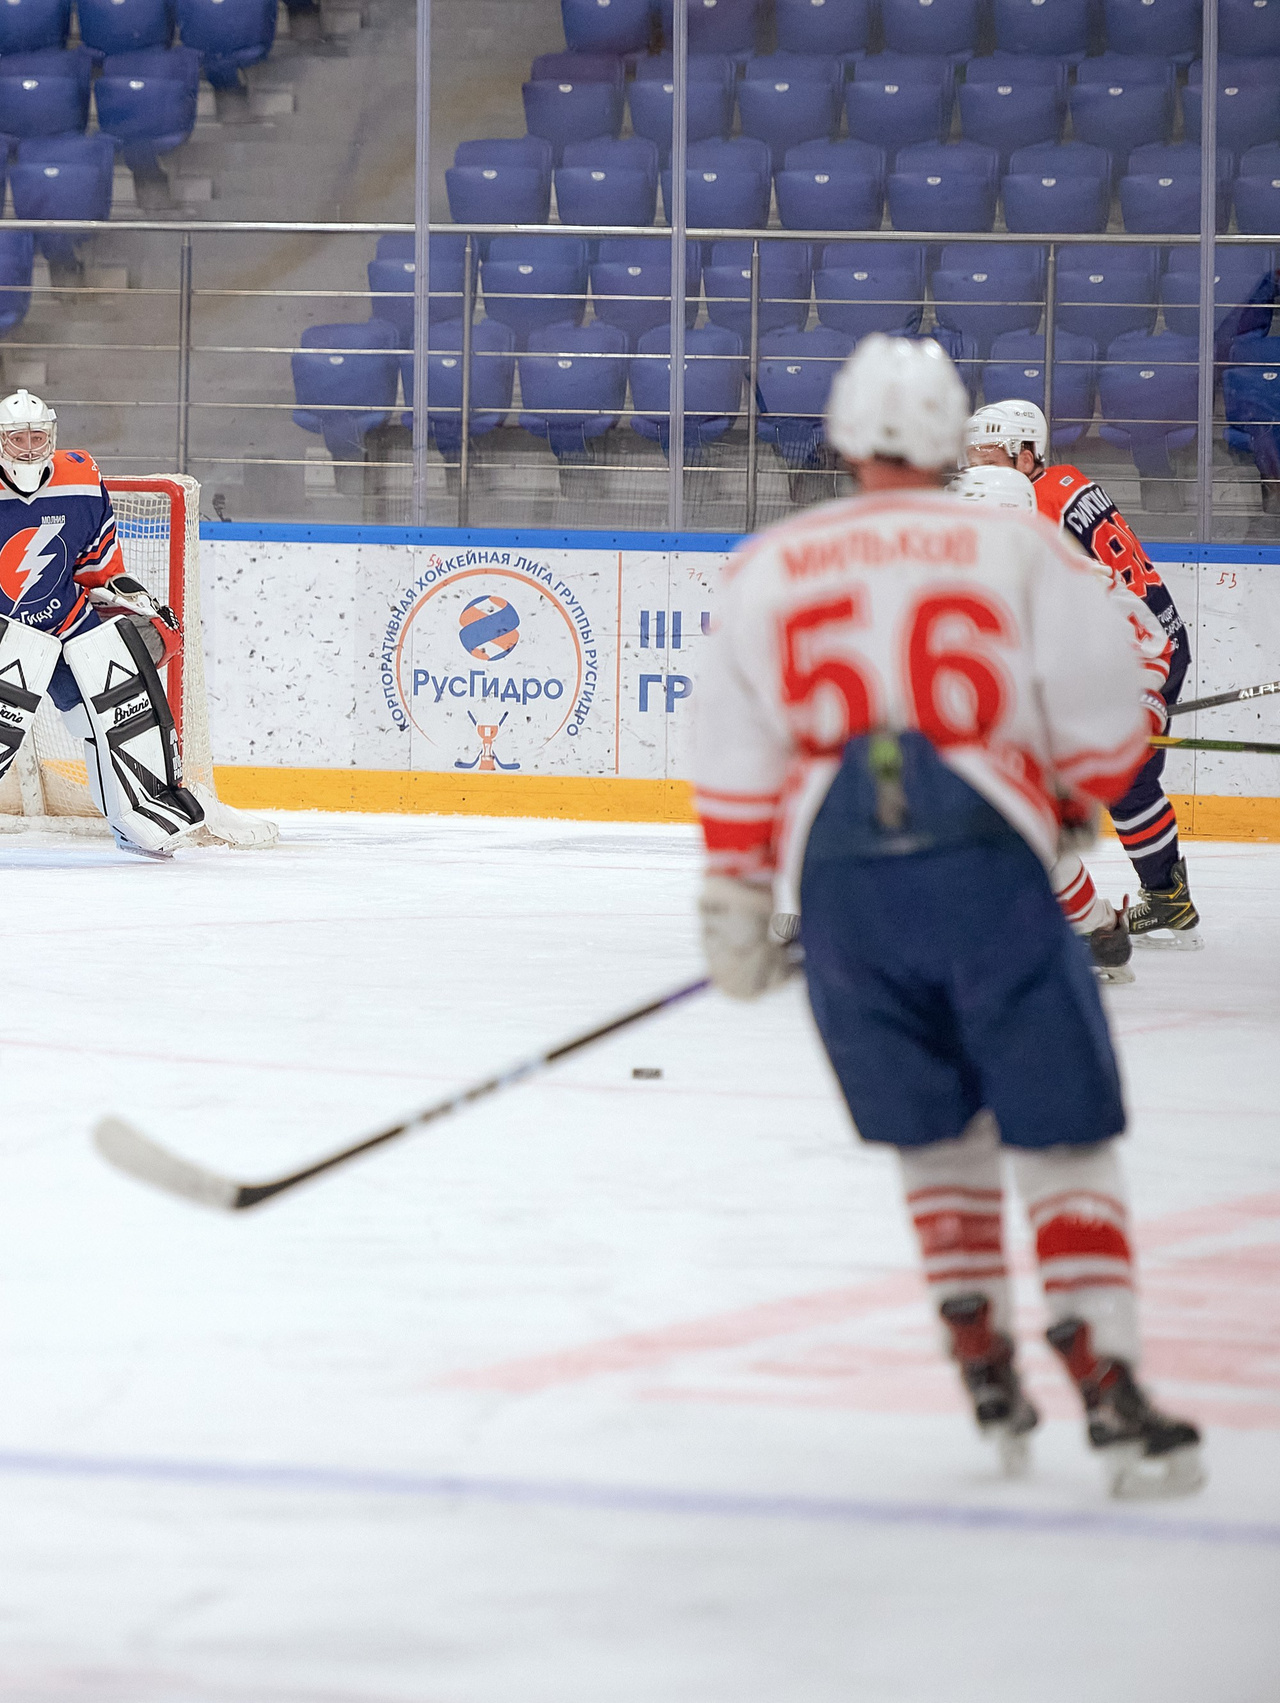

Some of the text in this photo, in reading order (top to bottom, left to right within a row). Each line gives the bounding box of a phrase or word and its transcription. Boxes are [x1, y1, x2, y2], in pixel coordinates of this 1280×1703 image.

[381, 549, 599, 737] КОРПОРАТИВНАЯ ХОККЕЙНАЯ ЛИГА ГРУППЫ РУСГИДРО
[413, 669, 564, 704] РусГидро
[778, 588, 1012, 757] 56
[114, 698, 150, 725] Brian's
